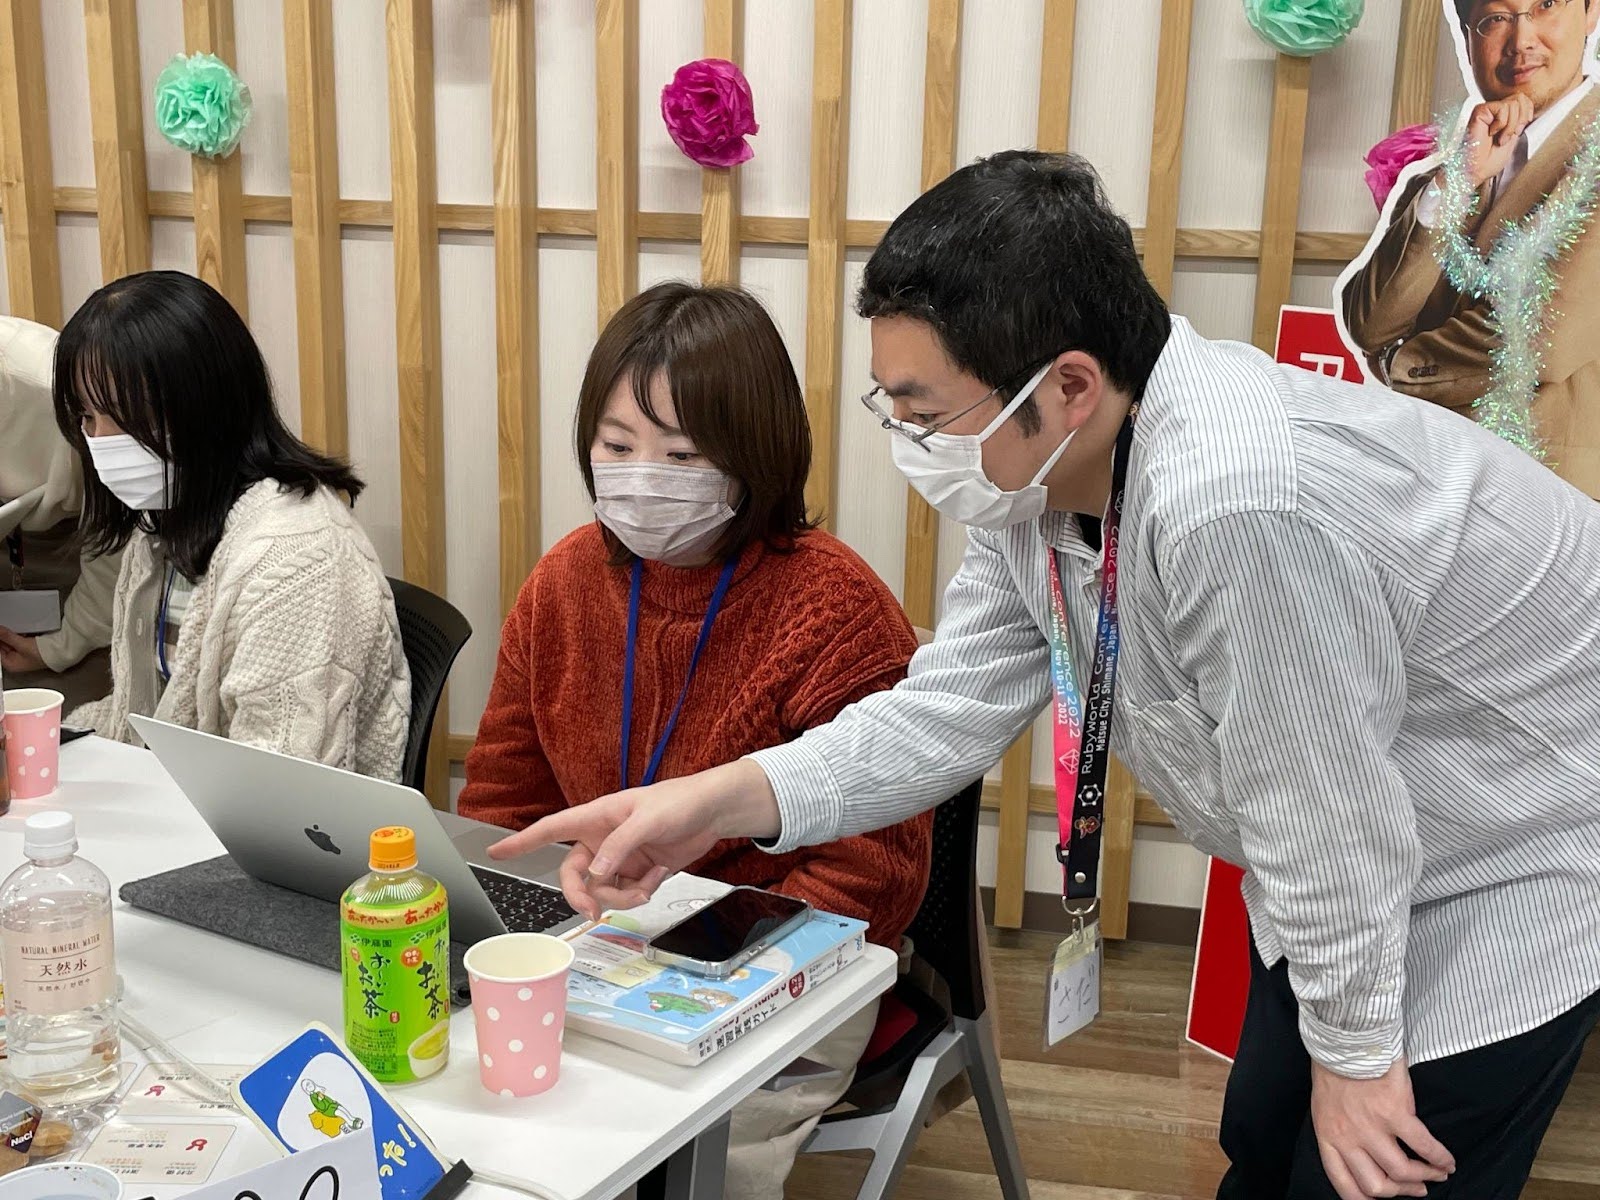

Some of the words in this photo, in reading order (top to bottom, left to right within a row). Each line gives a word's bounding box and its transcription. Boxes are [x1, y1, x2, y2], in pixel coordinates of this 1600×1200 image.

[1052, 613, 1060, 643] Japan,
[1106, 620, 1119, 650] Japan,
[1056, 589, 1074, 692] Conference
[1067, 693, 1081, 738] 2022
[1081, 682, 1101, 775] RubyWorld
[1094, 571, 1116, 675] Conference
[1101, 653, 1117, 695] Shimane,
[1056, 670, 1066, 696] 10-11
[1057, 702, 1068, 725] 2022
[1099, 697, 1112, 718] City,
[1096, 720, 1108, 752] Matsue
[21, 945, 49, 955] NATURAL
[52, 941, 80, 954] MINERAL
[82, 933, 100, 947] WATER
[40, 958, 87, 977] 天然水
[357, 961, 388, 1019] お茶
[11, 1130, 33, 1147] NaCl
